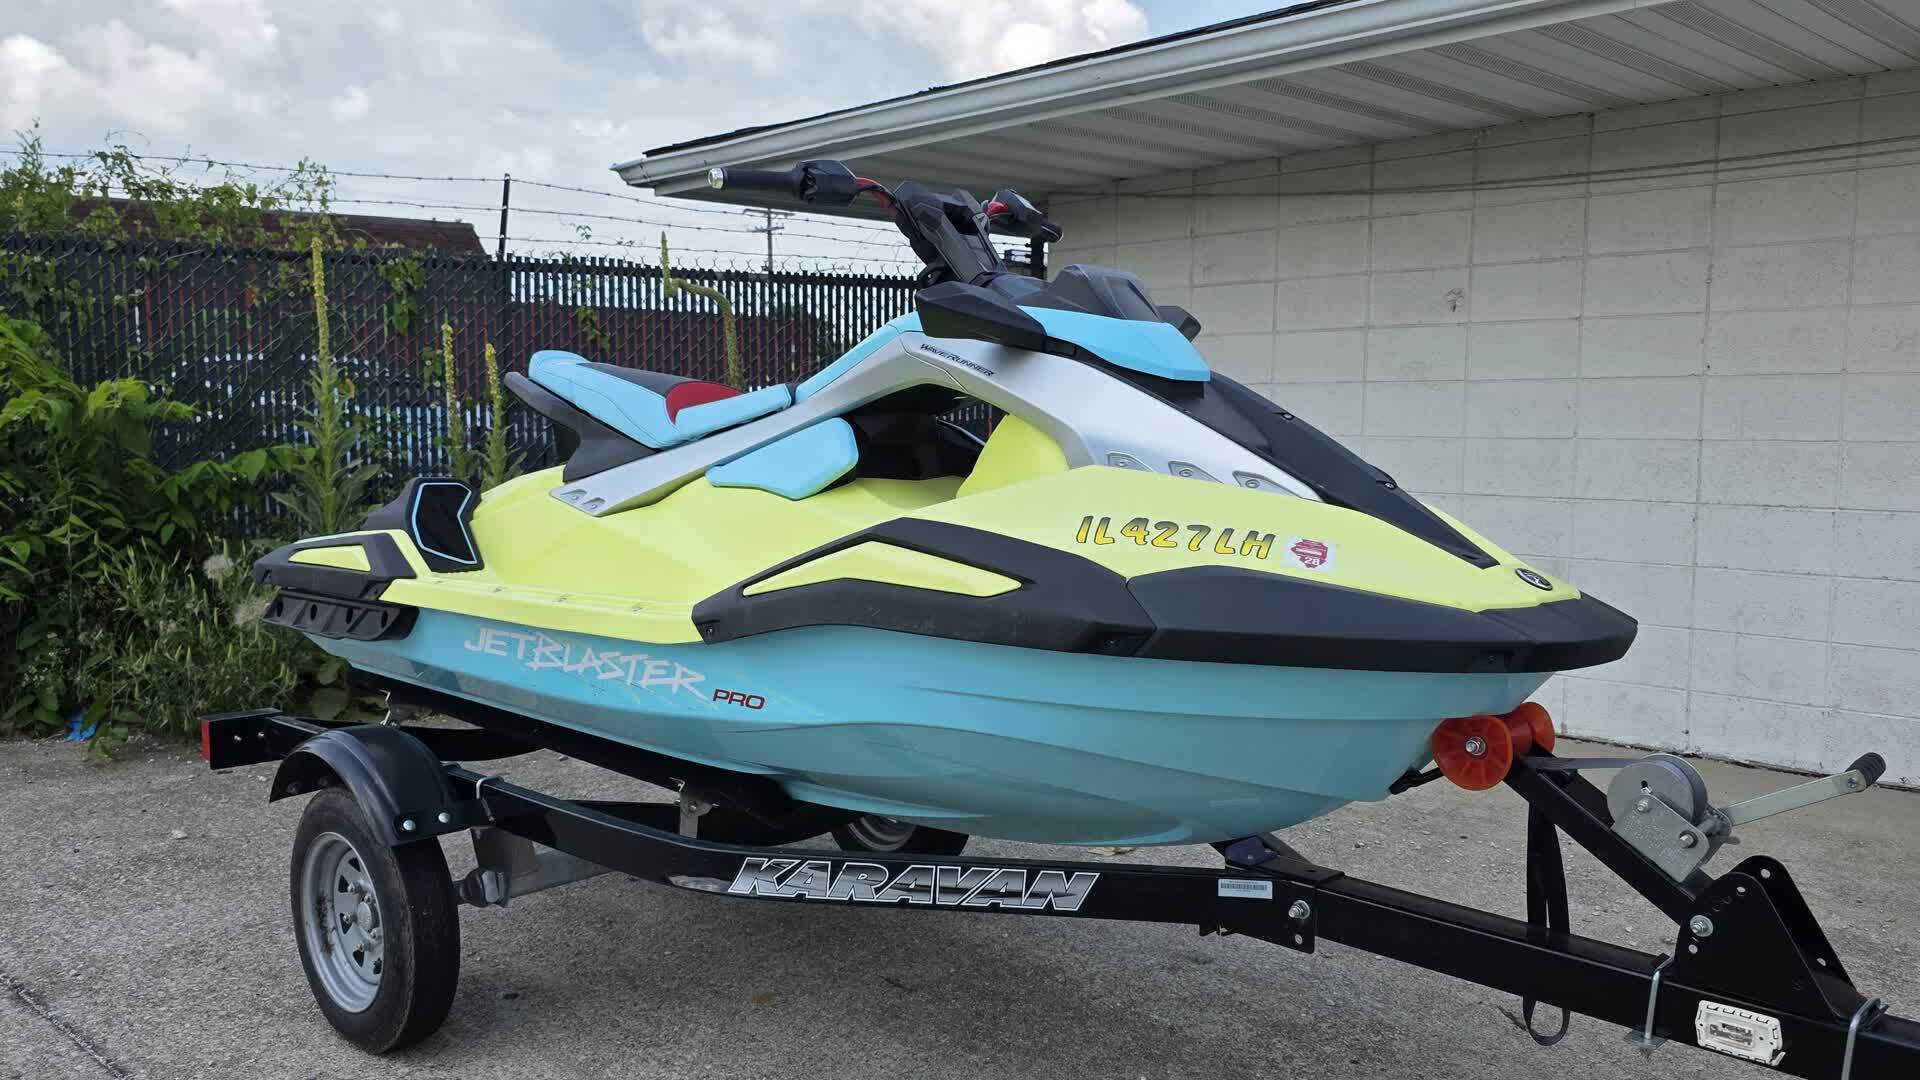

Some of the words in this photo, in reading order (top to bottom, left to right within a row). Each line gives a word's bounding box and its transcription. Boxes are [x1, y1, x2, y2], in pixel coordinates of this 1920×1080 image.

[1304, 556, 1320, 566] 28
[464, 627, 712, 702] JETBLASTER
[712, 688, 765, 710] PRO
[727, 857, 1100, 911] KARAVAN
